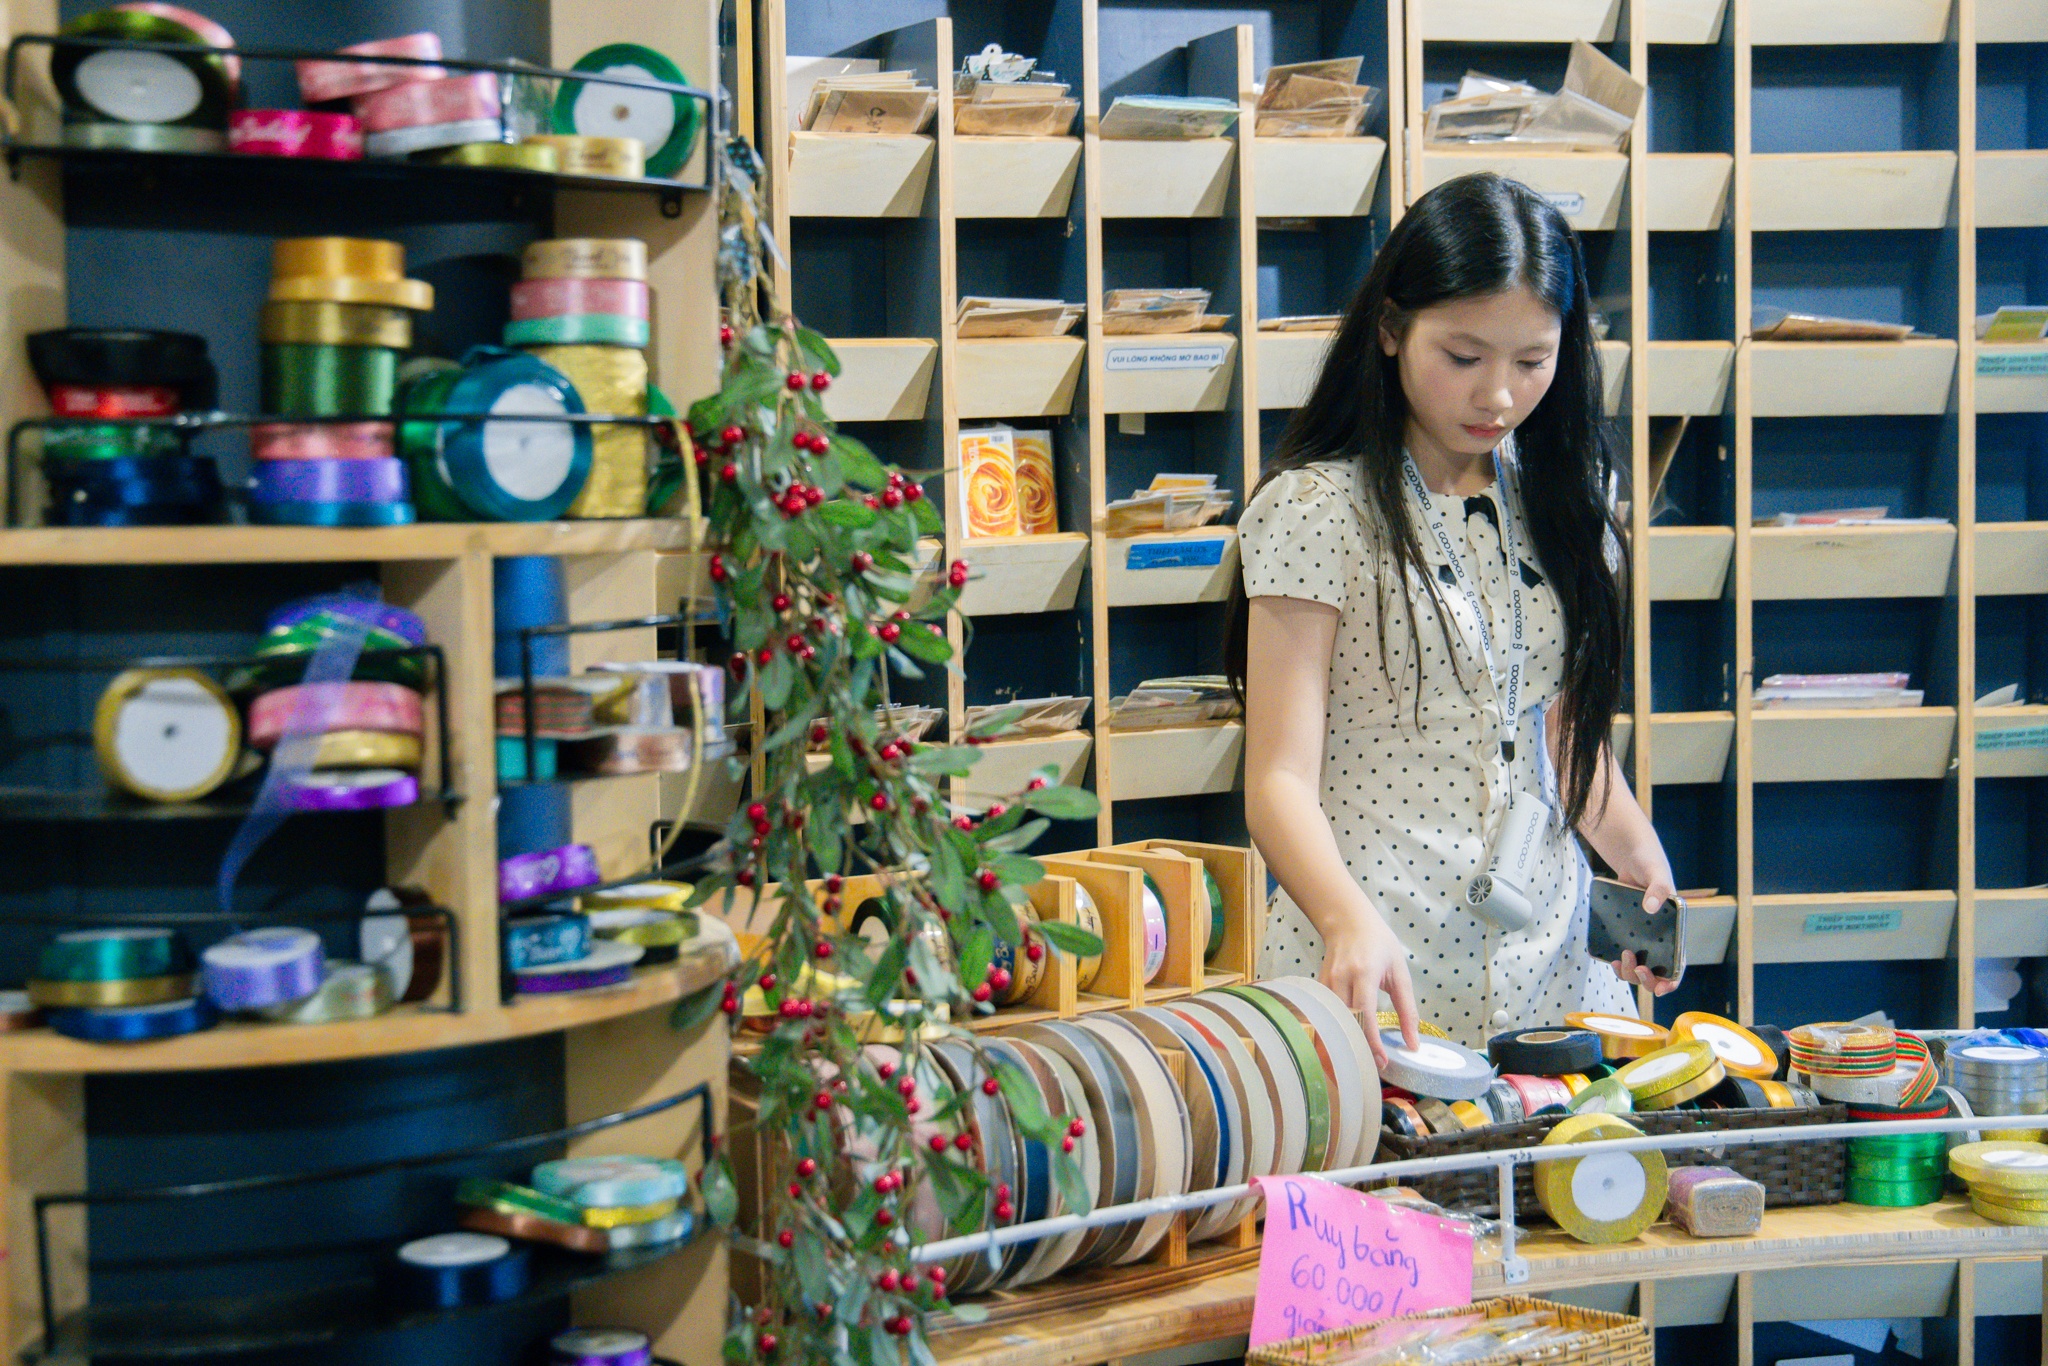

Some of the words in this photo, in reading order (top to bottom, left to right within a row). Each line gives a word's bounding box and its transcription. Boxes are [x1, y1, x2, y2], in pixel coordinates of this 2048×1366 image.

[1150, 353, 1177, 363] KHÔNG
[1284, 1181, 1346, 1270] Ruy
[1353, 1225, 1419, 1288] băng
